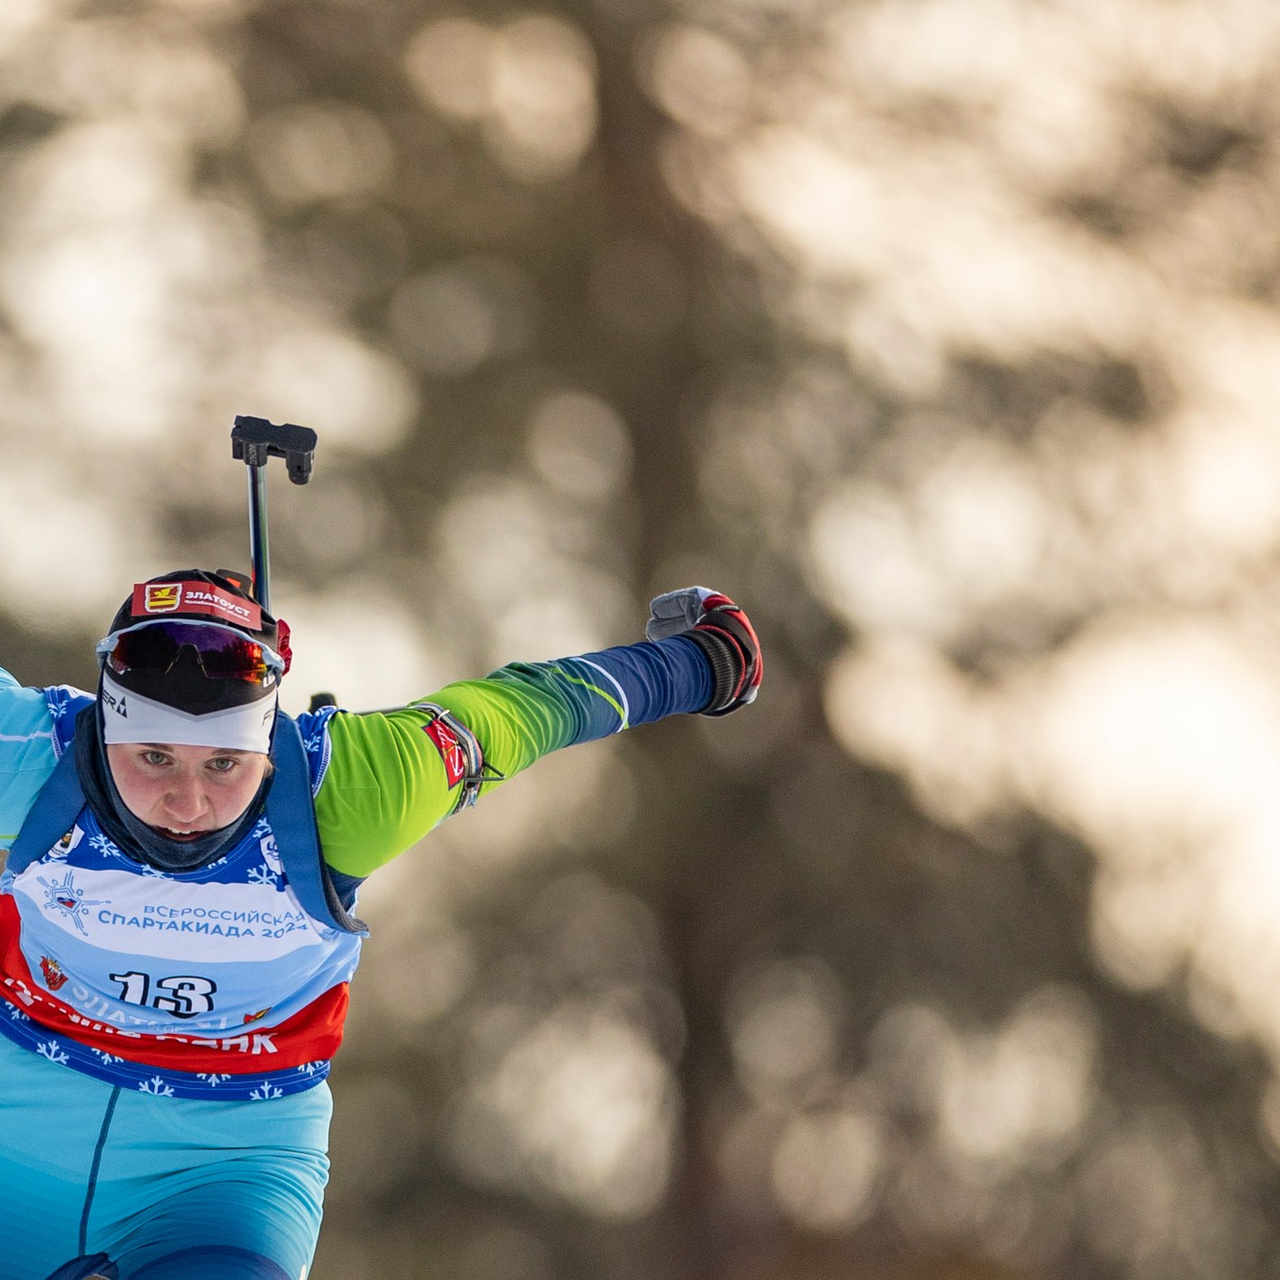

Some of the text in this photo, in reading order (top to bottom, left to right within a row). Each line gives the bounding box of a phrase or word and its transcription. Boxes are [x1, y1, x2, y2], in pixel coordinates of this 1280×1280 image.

[185, 591, 251, 616] ЗЛАТОУСТ
[98, 909, 310, 939] СПАРТАКИАДА 2024
[143, 905, 306, 927] ВСЕРОССИЙСКАЯ
[109, 971, 218, 1019] 13
